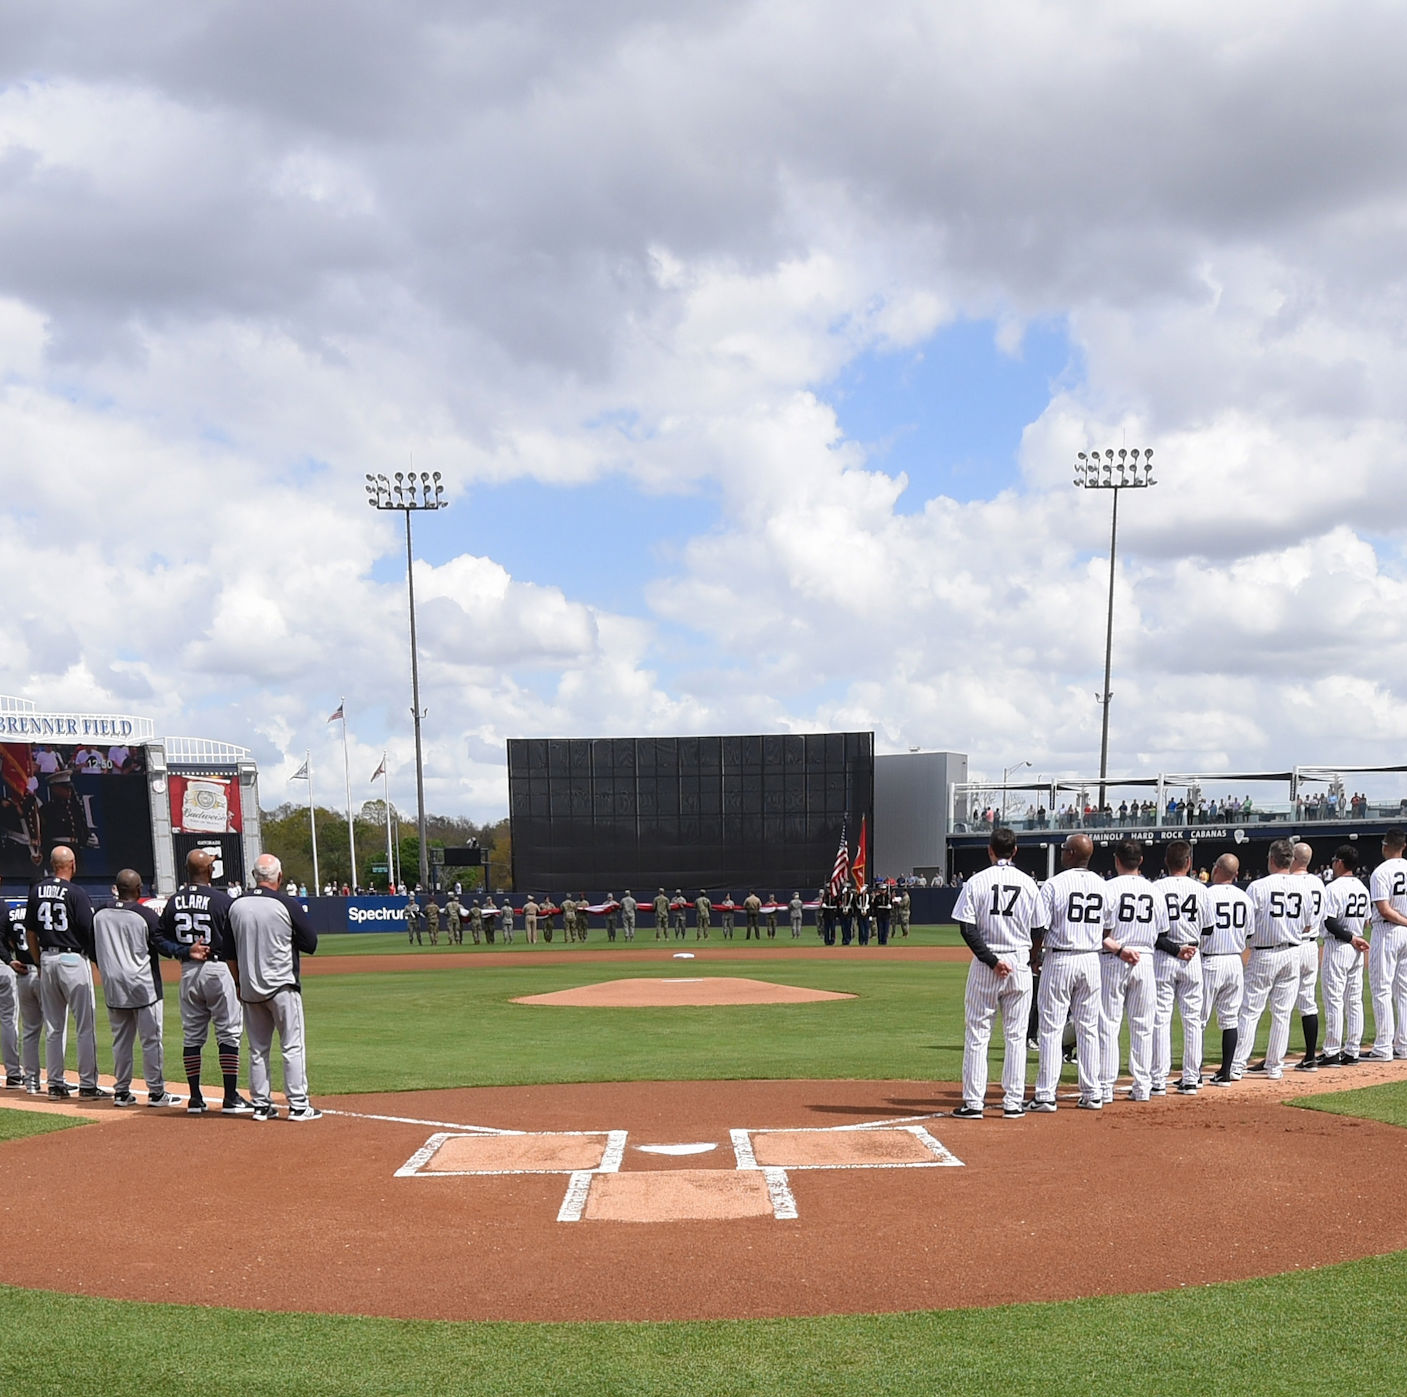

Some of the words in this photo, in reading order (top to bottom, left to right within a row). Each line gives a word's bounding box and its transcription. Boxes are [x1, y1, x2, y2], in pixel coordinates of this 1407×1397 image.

[82, 718, 133, 737] FIELD
[1088, 832, 1124, 841] EMINOLE
[1131, 831, 1155, 840] HARD
[1160, 830, 1183, 839] ROCK
[1190, 829, 1227, 838] CABANAS
[174, 894, 211, 911] CLARK
[348, 906, 408, 924] Spectru
[990, 884, 1021, 917] 17
[1067, 891, 1103, 924] 62
[1118, 892, 1154, 924] 63
[1165, 892, 1198, 922] 64
[1270, 891, 1303, 919] 53
[1345, 893, 1368, 918] 22
[37, 901, 69, 932] 43
[173, 912, 212, 945] 25
[1215, 901, 1247, 930] 50
